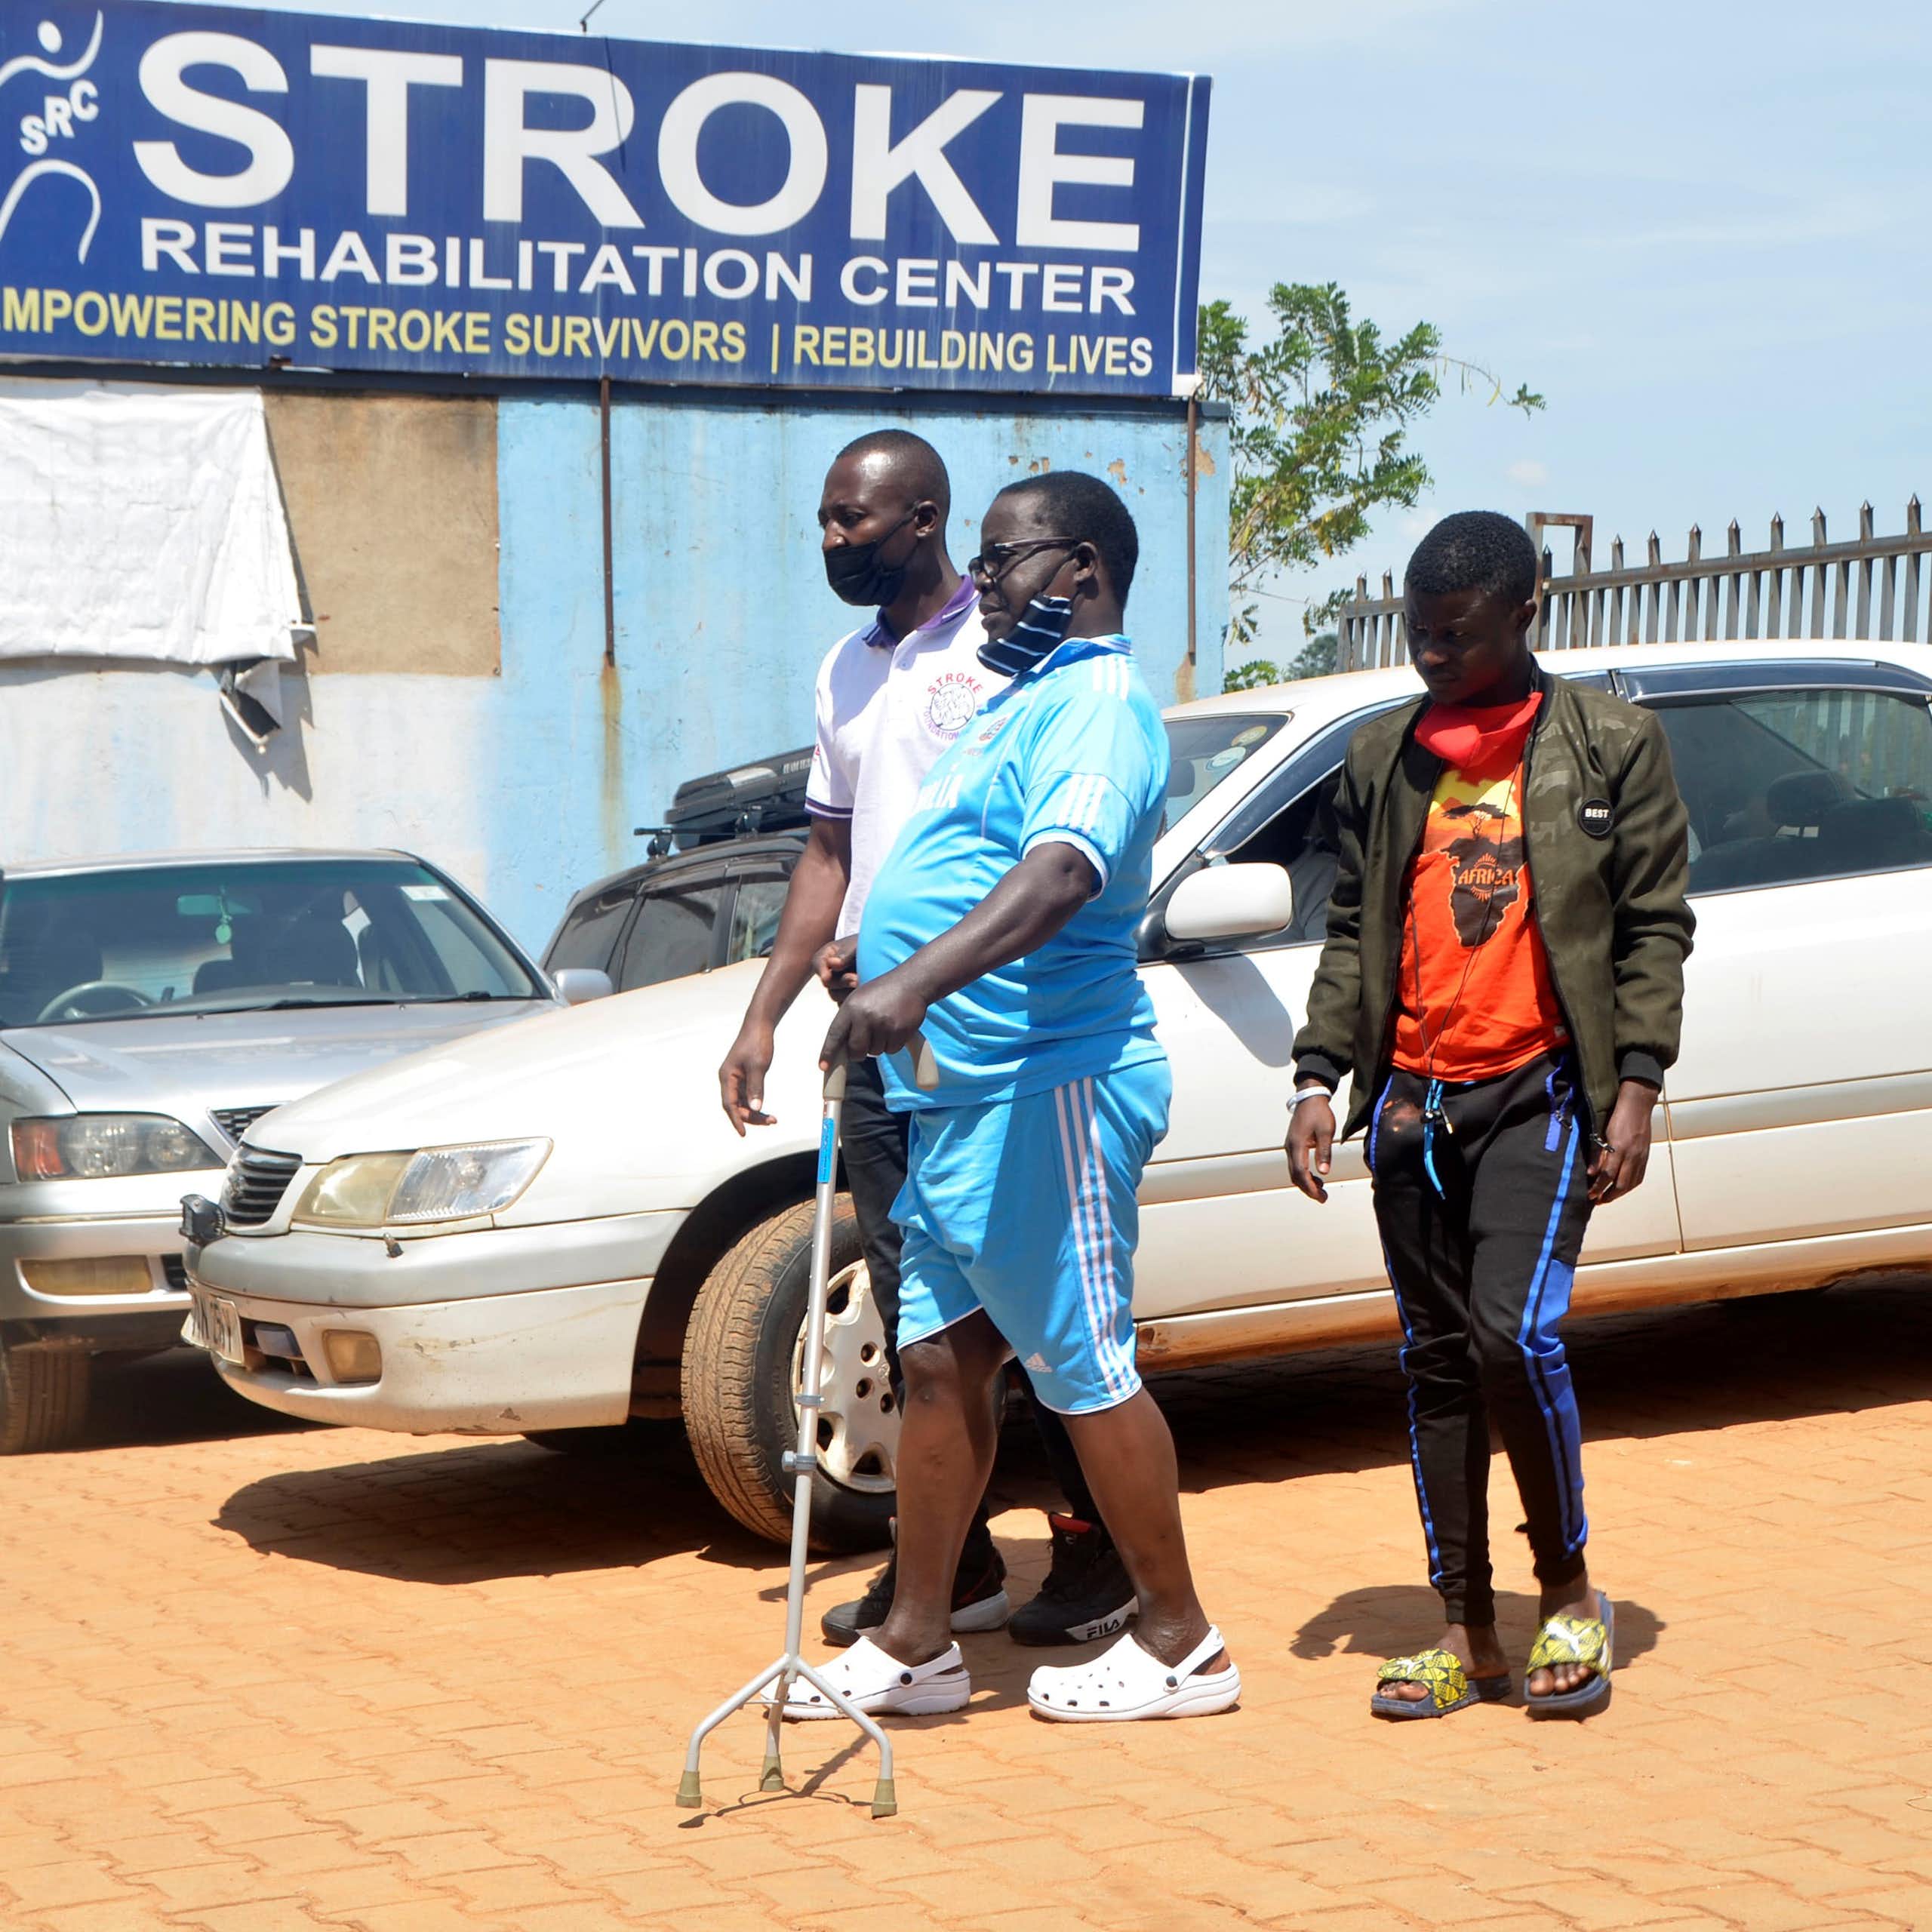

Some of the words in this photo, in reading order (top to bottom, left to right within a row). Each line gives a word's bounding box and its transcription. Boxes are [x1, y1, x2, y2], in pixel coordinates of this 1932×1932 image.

[20, 79, 99, 155] SRC
[132, 30, 1146, 253] STROKE
[140, 217, 813, 303] REHABILITATION
[839, 255, 1137, 317] CENTER
[0, 286, 297, 347] MPOWERING
[309, 303, 491, 355] STROKE
[503, 312, 747, 365] SURVIVORS
[792, 324, 1035, 373] REBUILDING
[1046, 334, 1154, 378] LIVES
[928, 672, 983, 695] STROKE
[1584, 808, 1609, 818] BEST
[1457, 868, 1515, 886] AFRICA
[1087, 1619, 1121, 1638] FILA
